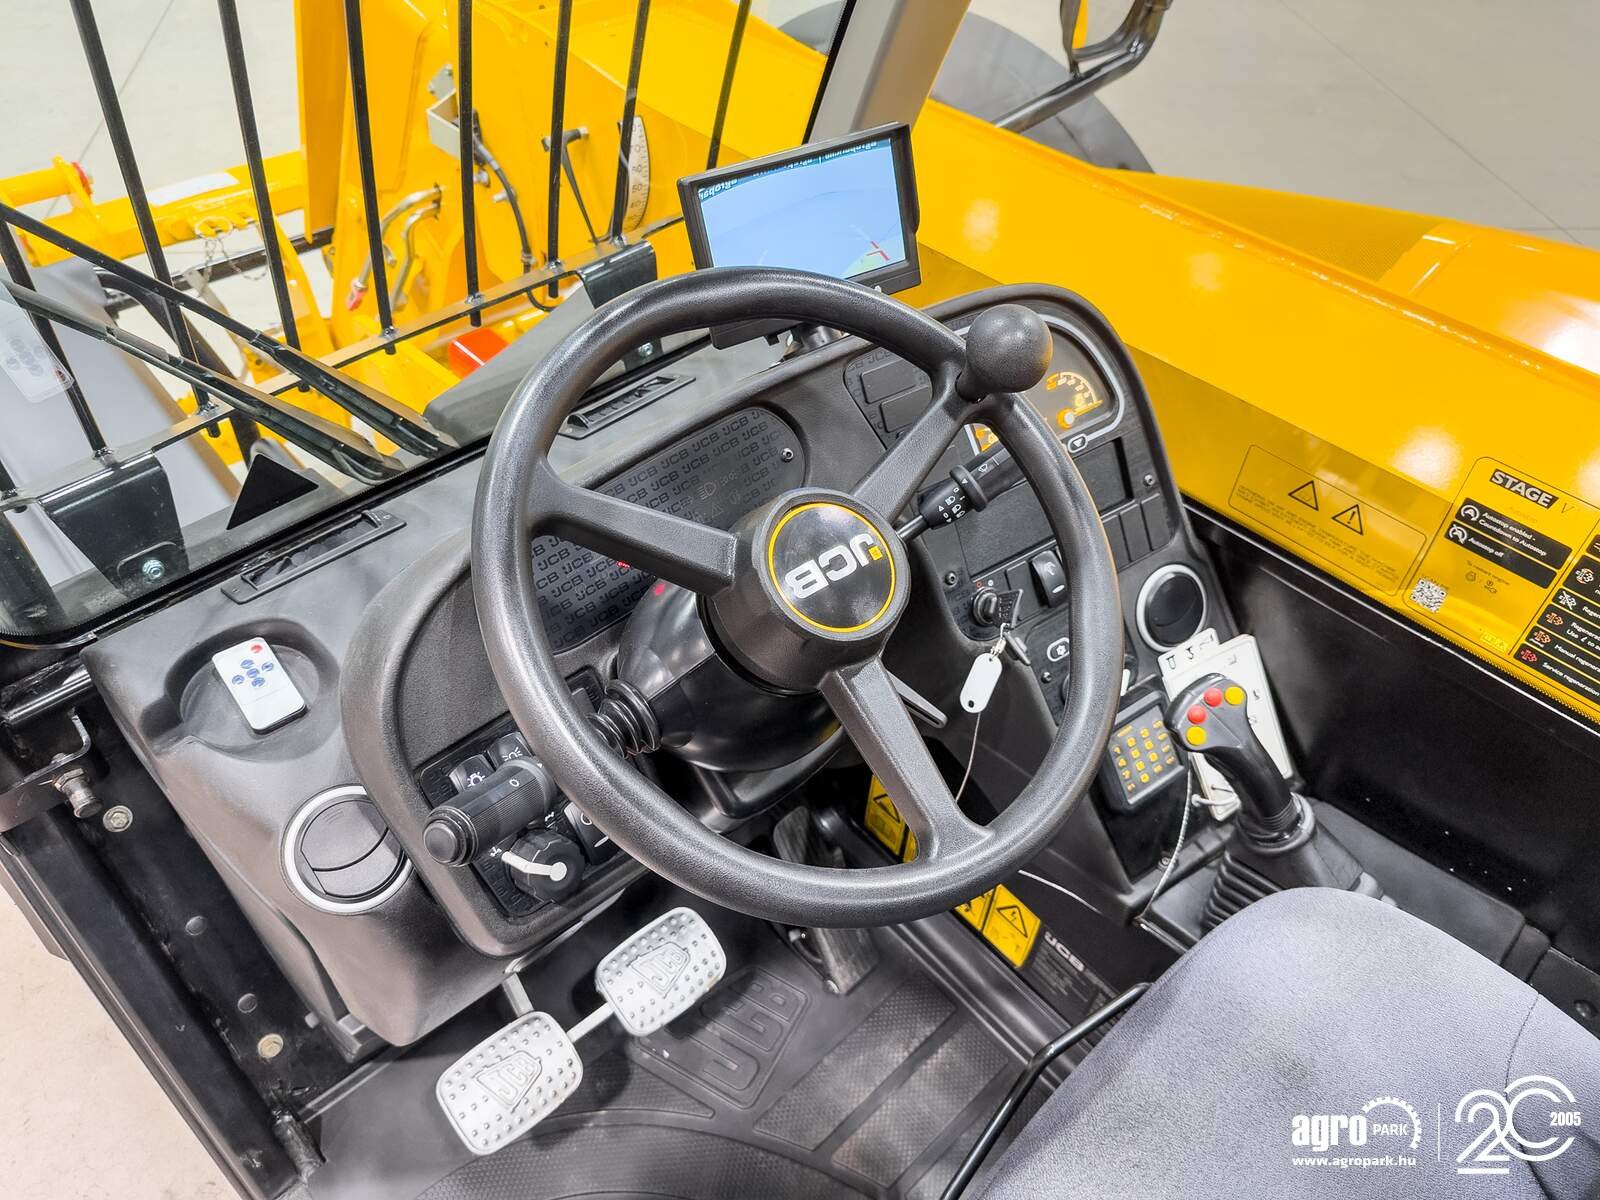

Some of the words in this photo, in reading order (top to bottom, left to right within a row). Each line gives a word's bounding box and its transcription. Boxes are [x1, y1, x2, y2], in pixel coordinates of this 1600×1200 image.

[603, 483, 625, 498] CB
[661, 448, 690, 468] JCB
[692, 432, 720, 450] JCB
[722, 416, 749, 435] JCB
[624, 488, 648, 504] CB
[651, 471, 679, 492] JCB
[681, 454, 710, 473] JCB
[712, 438, 739, 457] JCB
[742, 421, 769, 441] JCB
[1491, 471, 1553, 507] STAGE
[1479, 519, 1512, 539] Countdown
[1520, 539, 1547, 556] Autostop
[1482, 512, 1509, 528] Autostop
[1509, 523, 1532, 540] enabled
[537, 548, 570, 571] JCB
[1468, 537, 1494, 554] Autostop
[1494, 550, 1504, 558] off
[535, 572, 560, 590] CB
[562, 551, 593, 575] JCB
[784, 533, 883, 599] JCB
[551, 575, 584, 598] JCB
[575, 579, 607, 601] JCB
[1566, 629, 1579, 639] Use
[1554, 644, 1576, 659] Manual
[1542, 661, 1564, 677] Service
[1044, 931, 1085, 972] JCB
